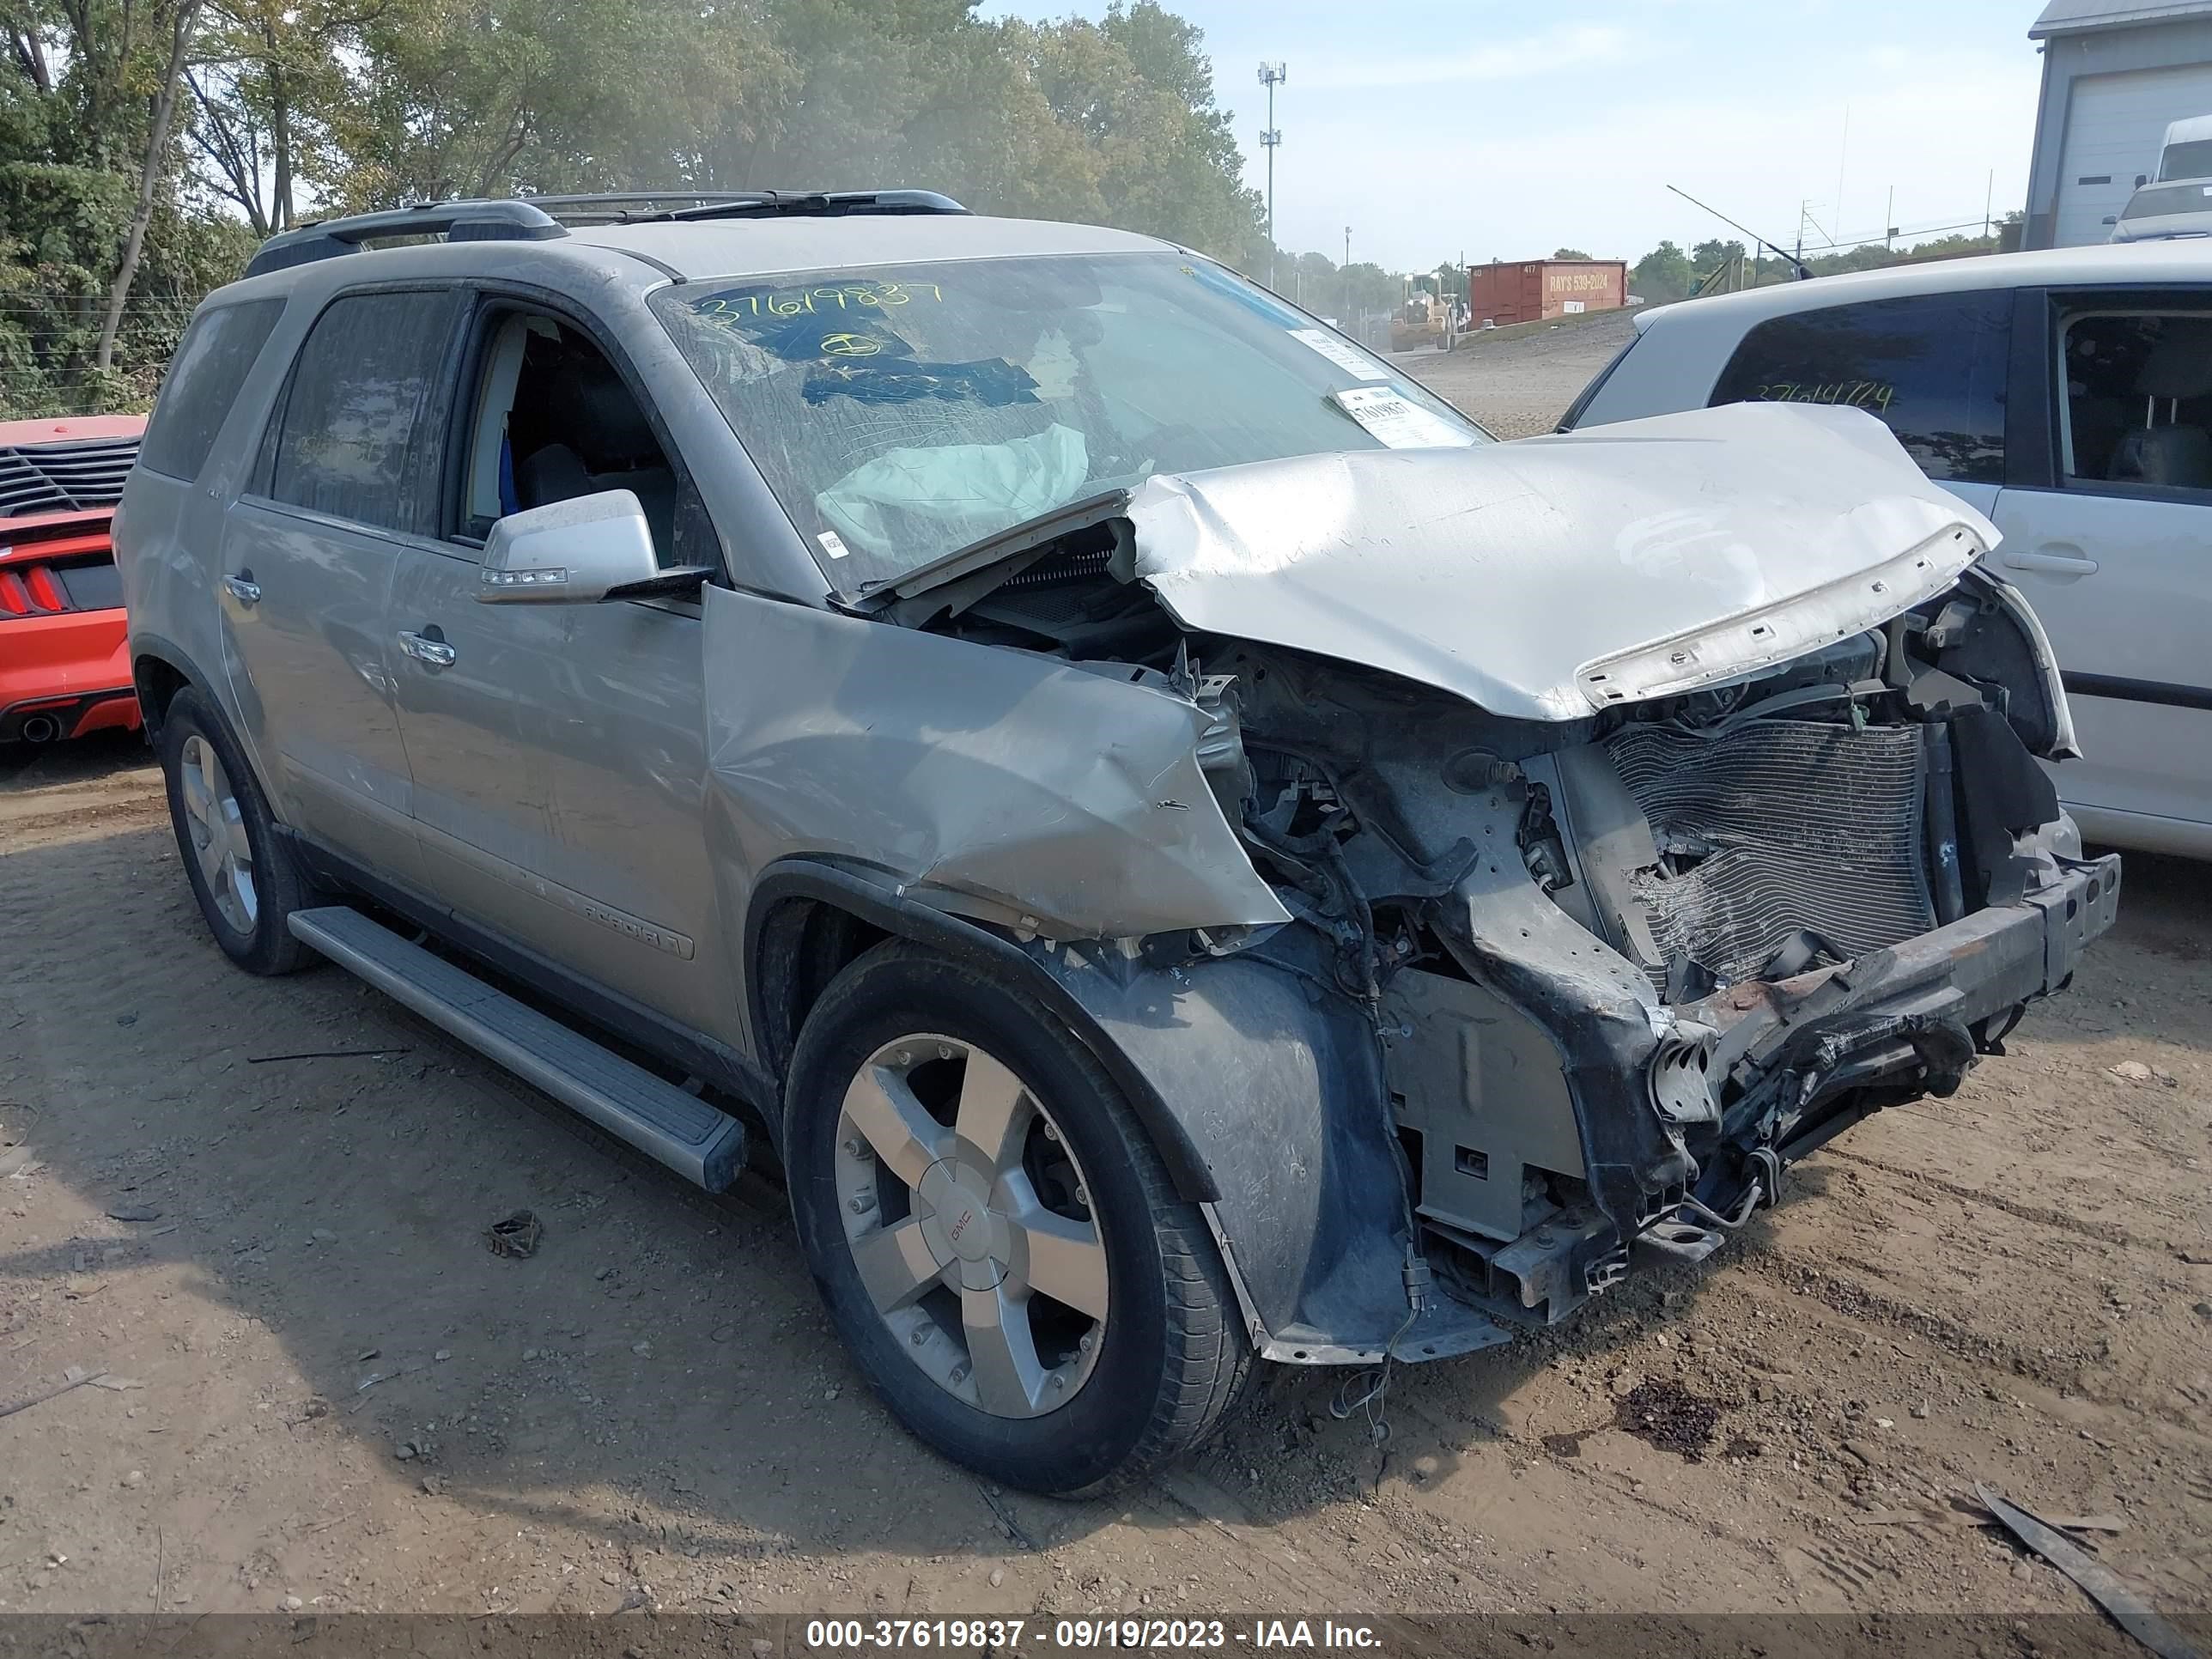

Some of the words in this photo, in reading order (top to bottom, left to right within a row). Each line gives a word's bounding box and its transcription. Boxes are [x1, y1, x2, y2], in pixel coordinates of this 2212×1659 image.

[1524, 264, 1535, 274] 417
[1551, 276, 1572, 291] RAY'S
[1574, 275, 1607, 290] 539-2024
[702, 284, 943, 325] 37619837
[1348, 401, 1411, 422] 37619837
[951, 1210, 972, 1241] GMC
